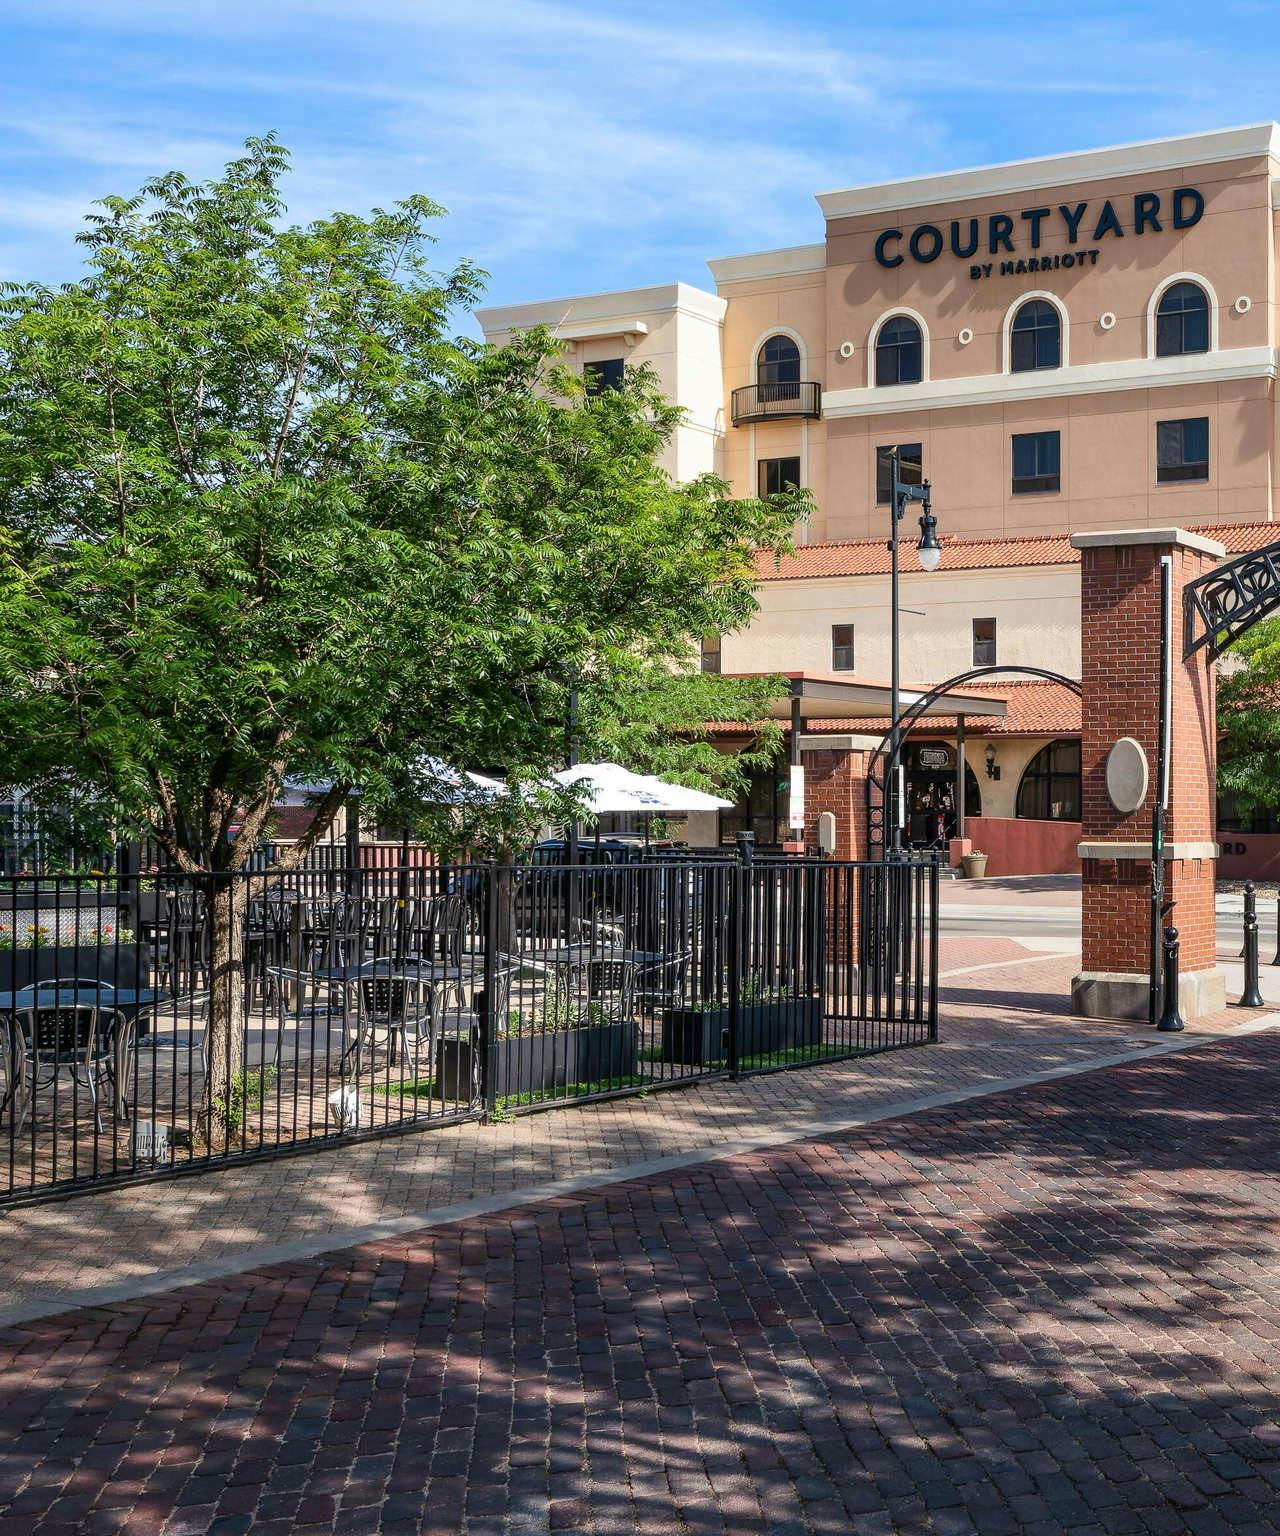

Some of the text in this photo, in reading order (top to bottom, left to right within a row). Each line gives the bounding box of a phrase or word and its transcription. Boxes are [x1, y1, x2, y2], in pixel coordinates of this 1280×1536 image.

[874, 187, 1205, 268] COURTYARD
[969, 249, 1100, 280] BY MARRIOTT
